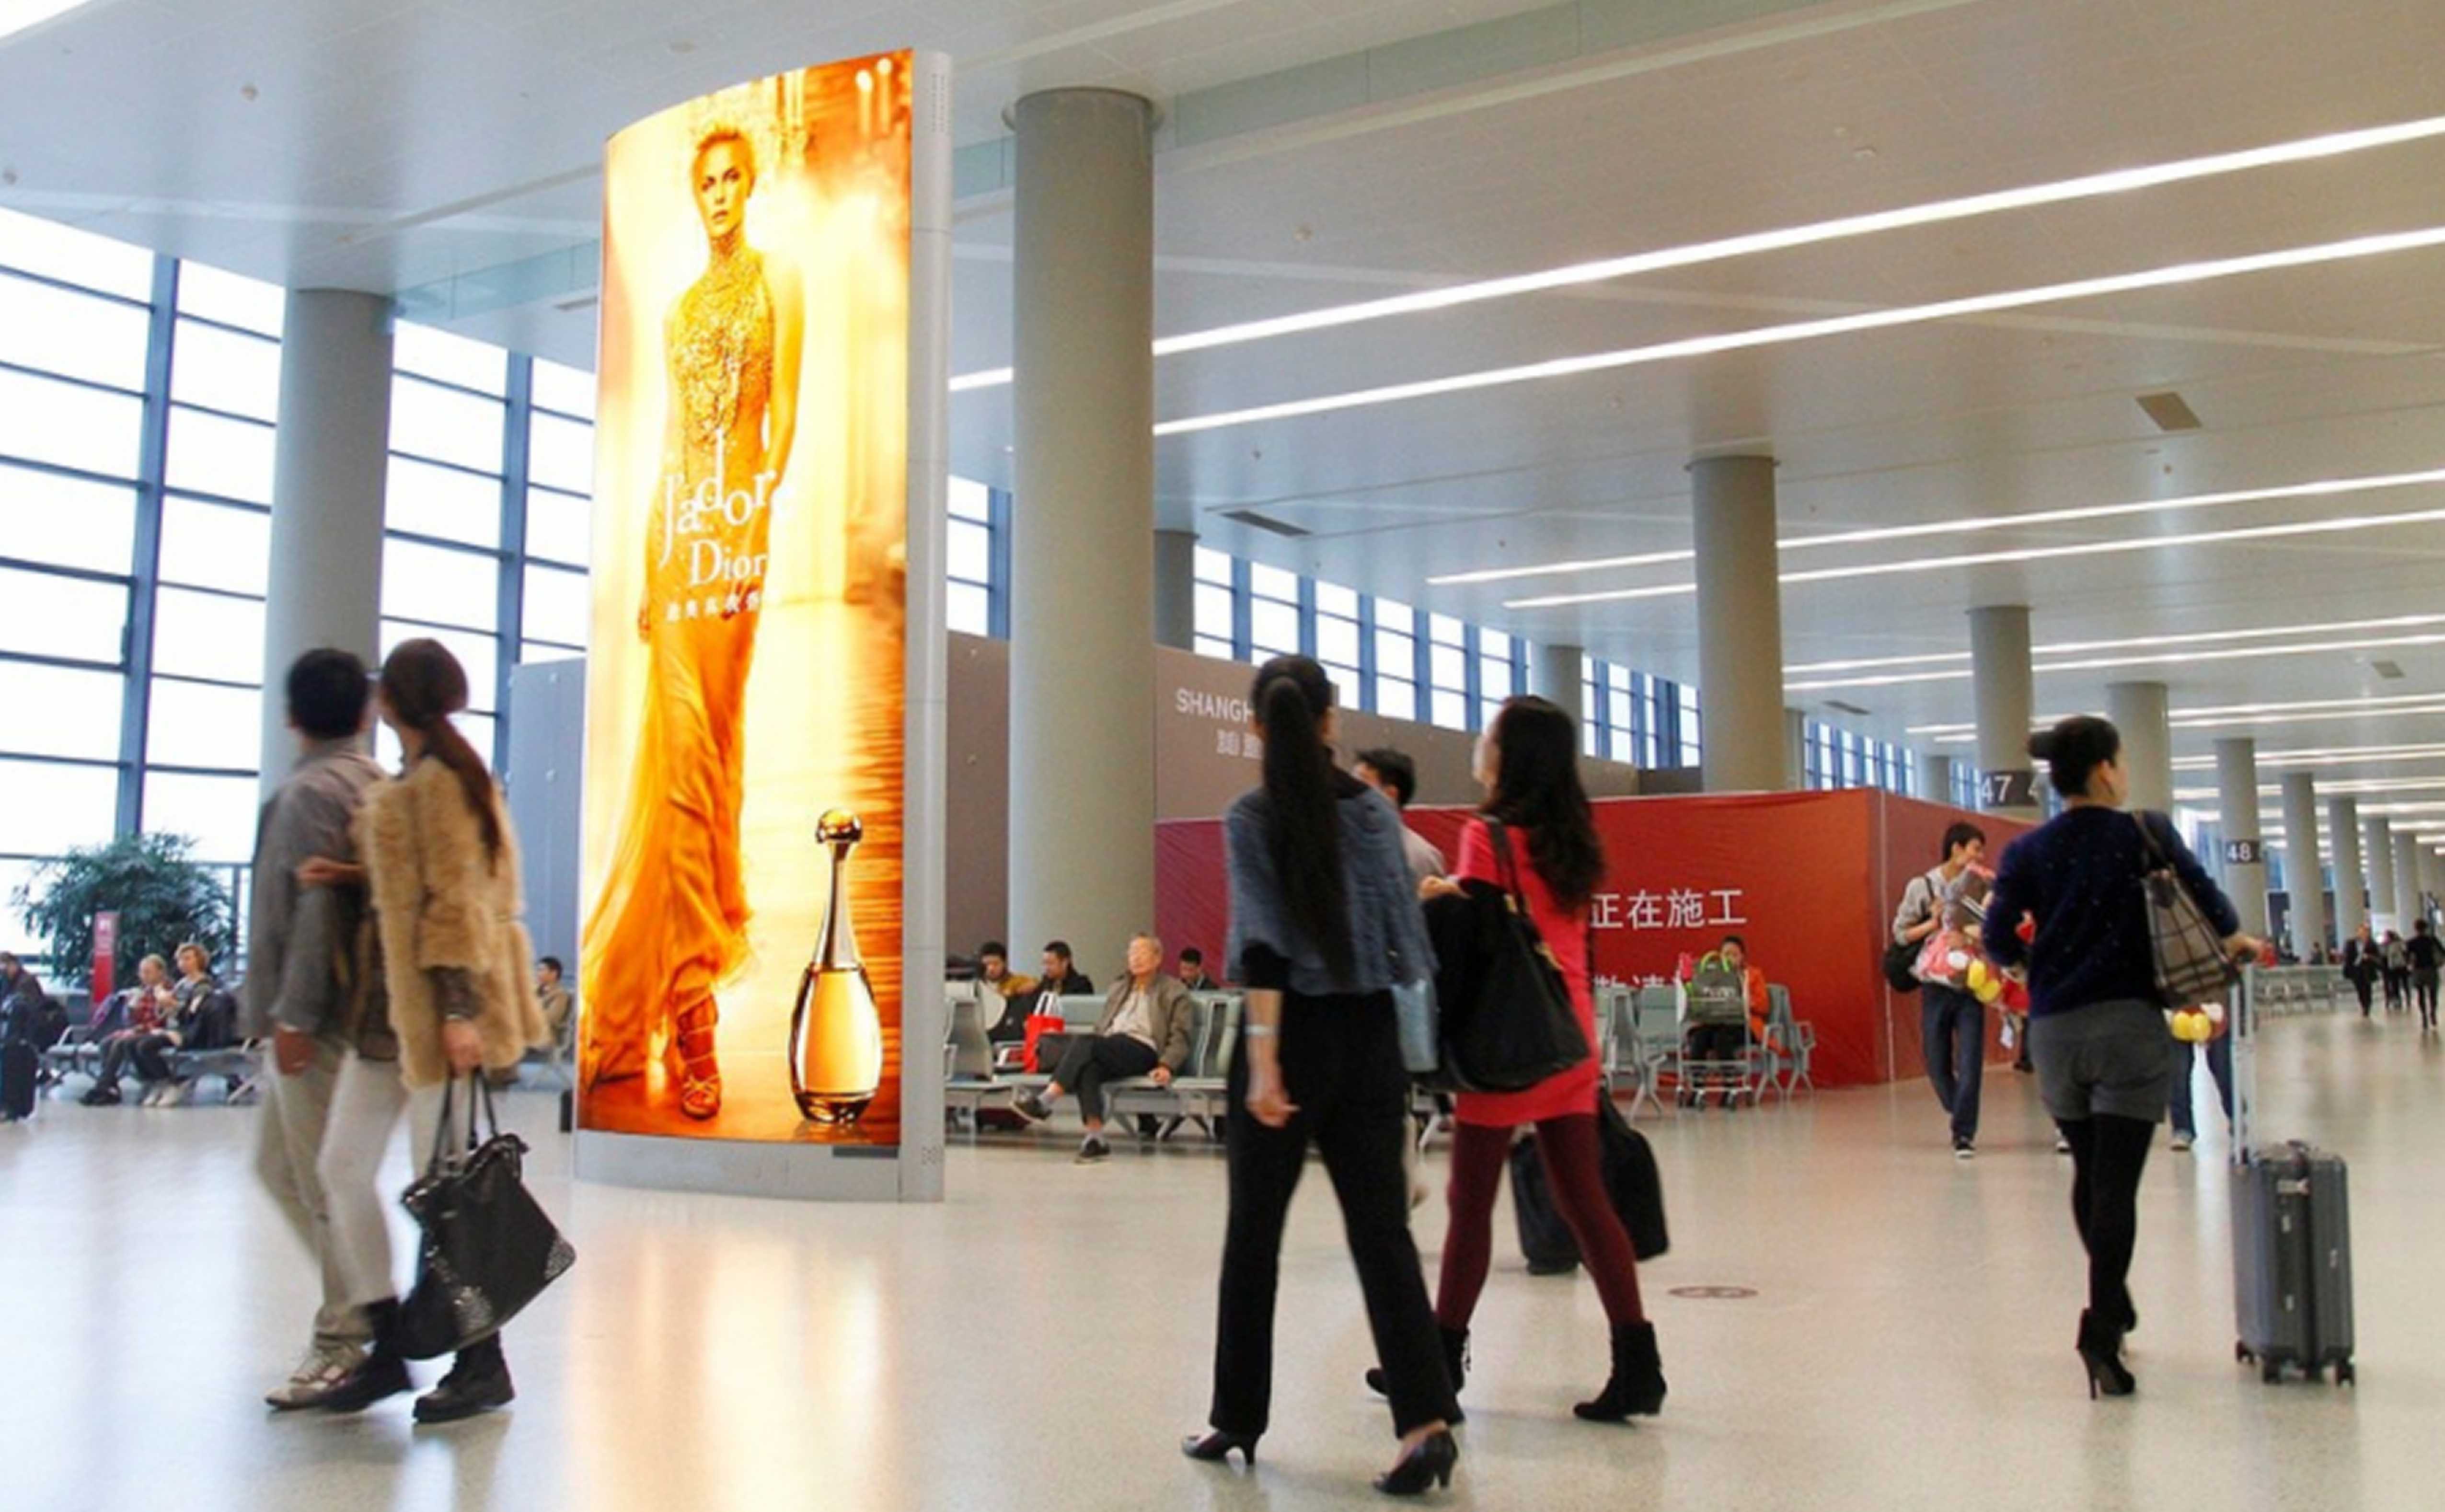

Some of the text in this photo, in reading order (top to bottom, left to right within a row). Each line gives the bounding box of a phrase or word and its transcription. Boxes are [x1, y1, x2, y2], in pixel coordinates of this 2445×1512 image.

[691, 539, 770, 585] Dior
[1981, 775, 2013, 804] 47
[2228, 842, 2251, 861] 48
[1590, 888, 1747, 930] 正在施工
